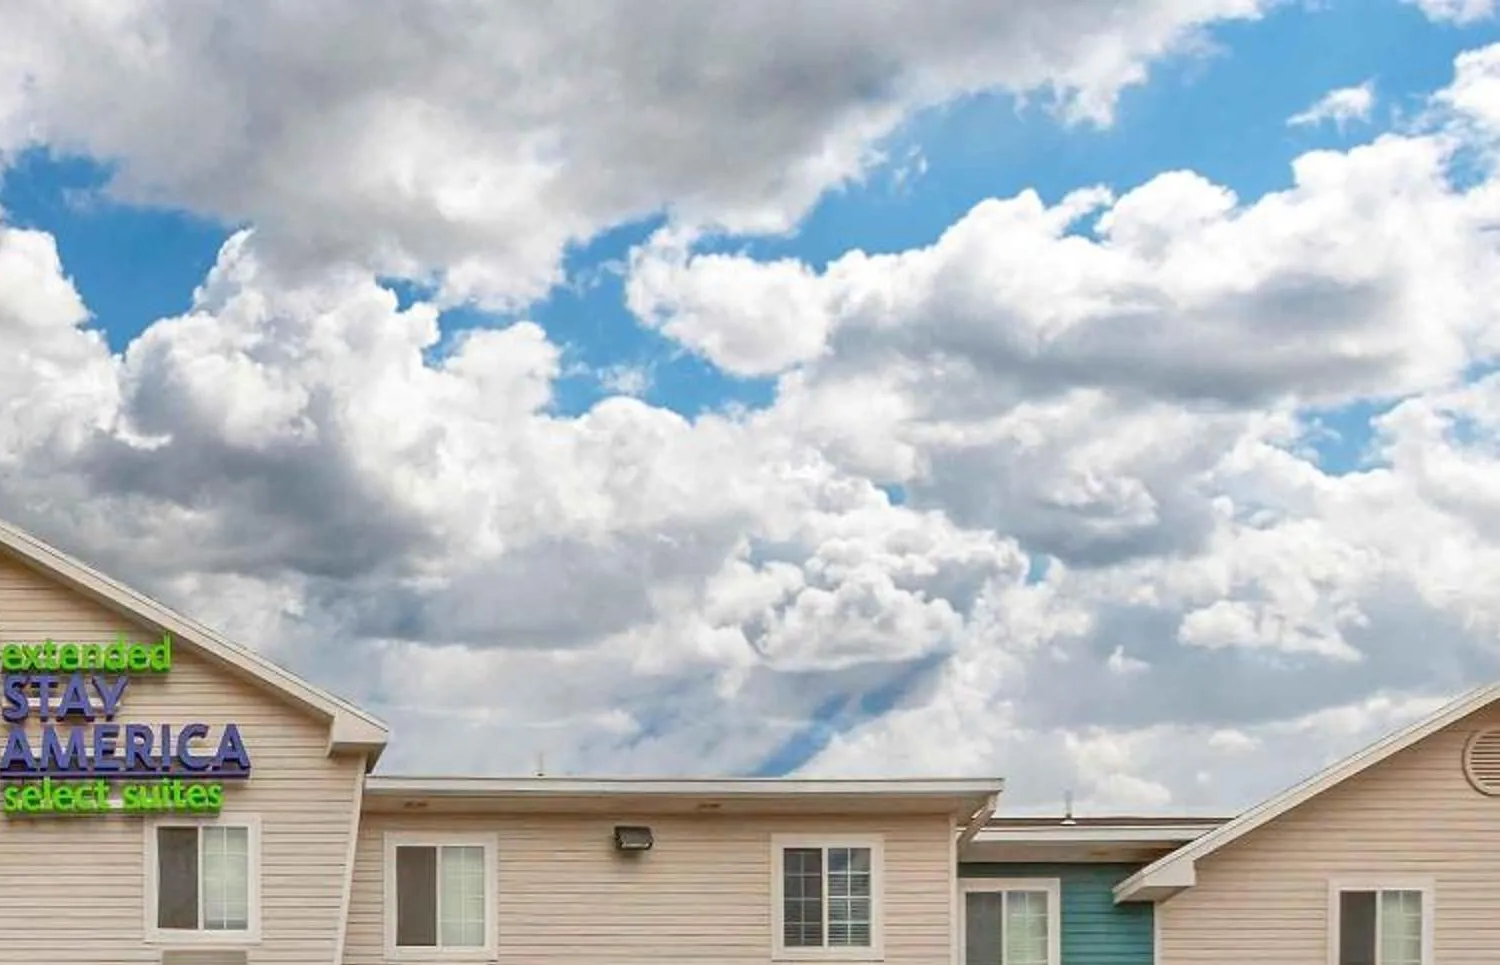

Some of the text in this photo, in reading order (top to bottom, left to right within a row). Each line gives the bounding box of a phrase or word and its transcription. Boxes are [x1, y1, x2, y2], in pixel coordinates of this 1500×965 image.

[0, 631, 173, 672] extended
[2, 672, 129, 723] STAY
[0, 723, 252, 772] AMERICA
[3, 776, 224, 816] select suites
